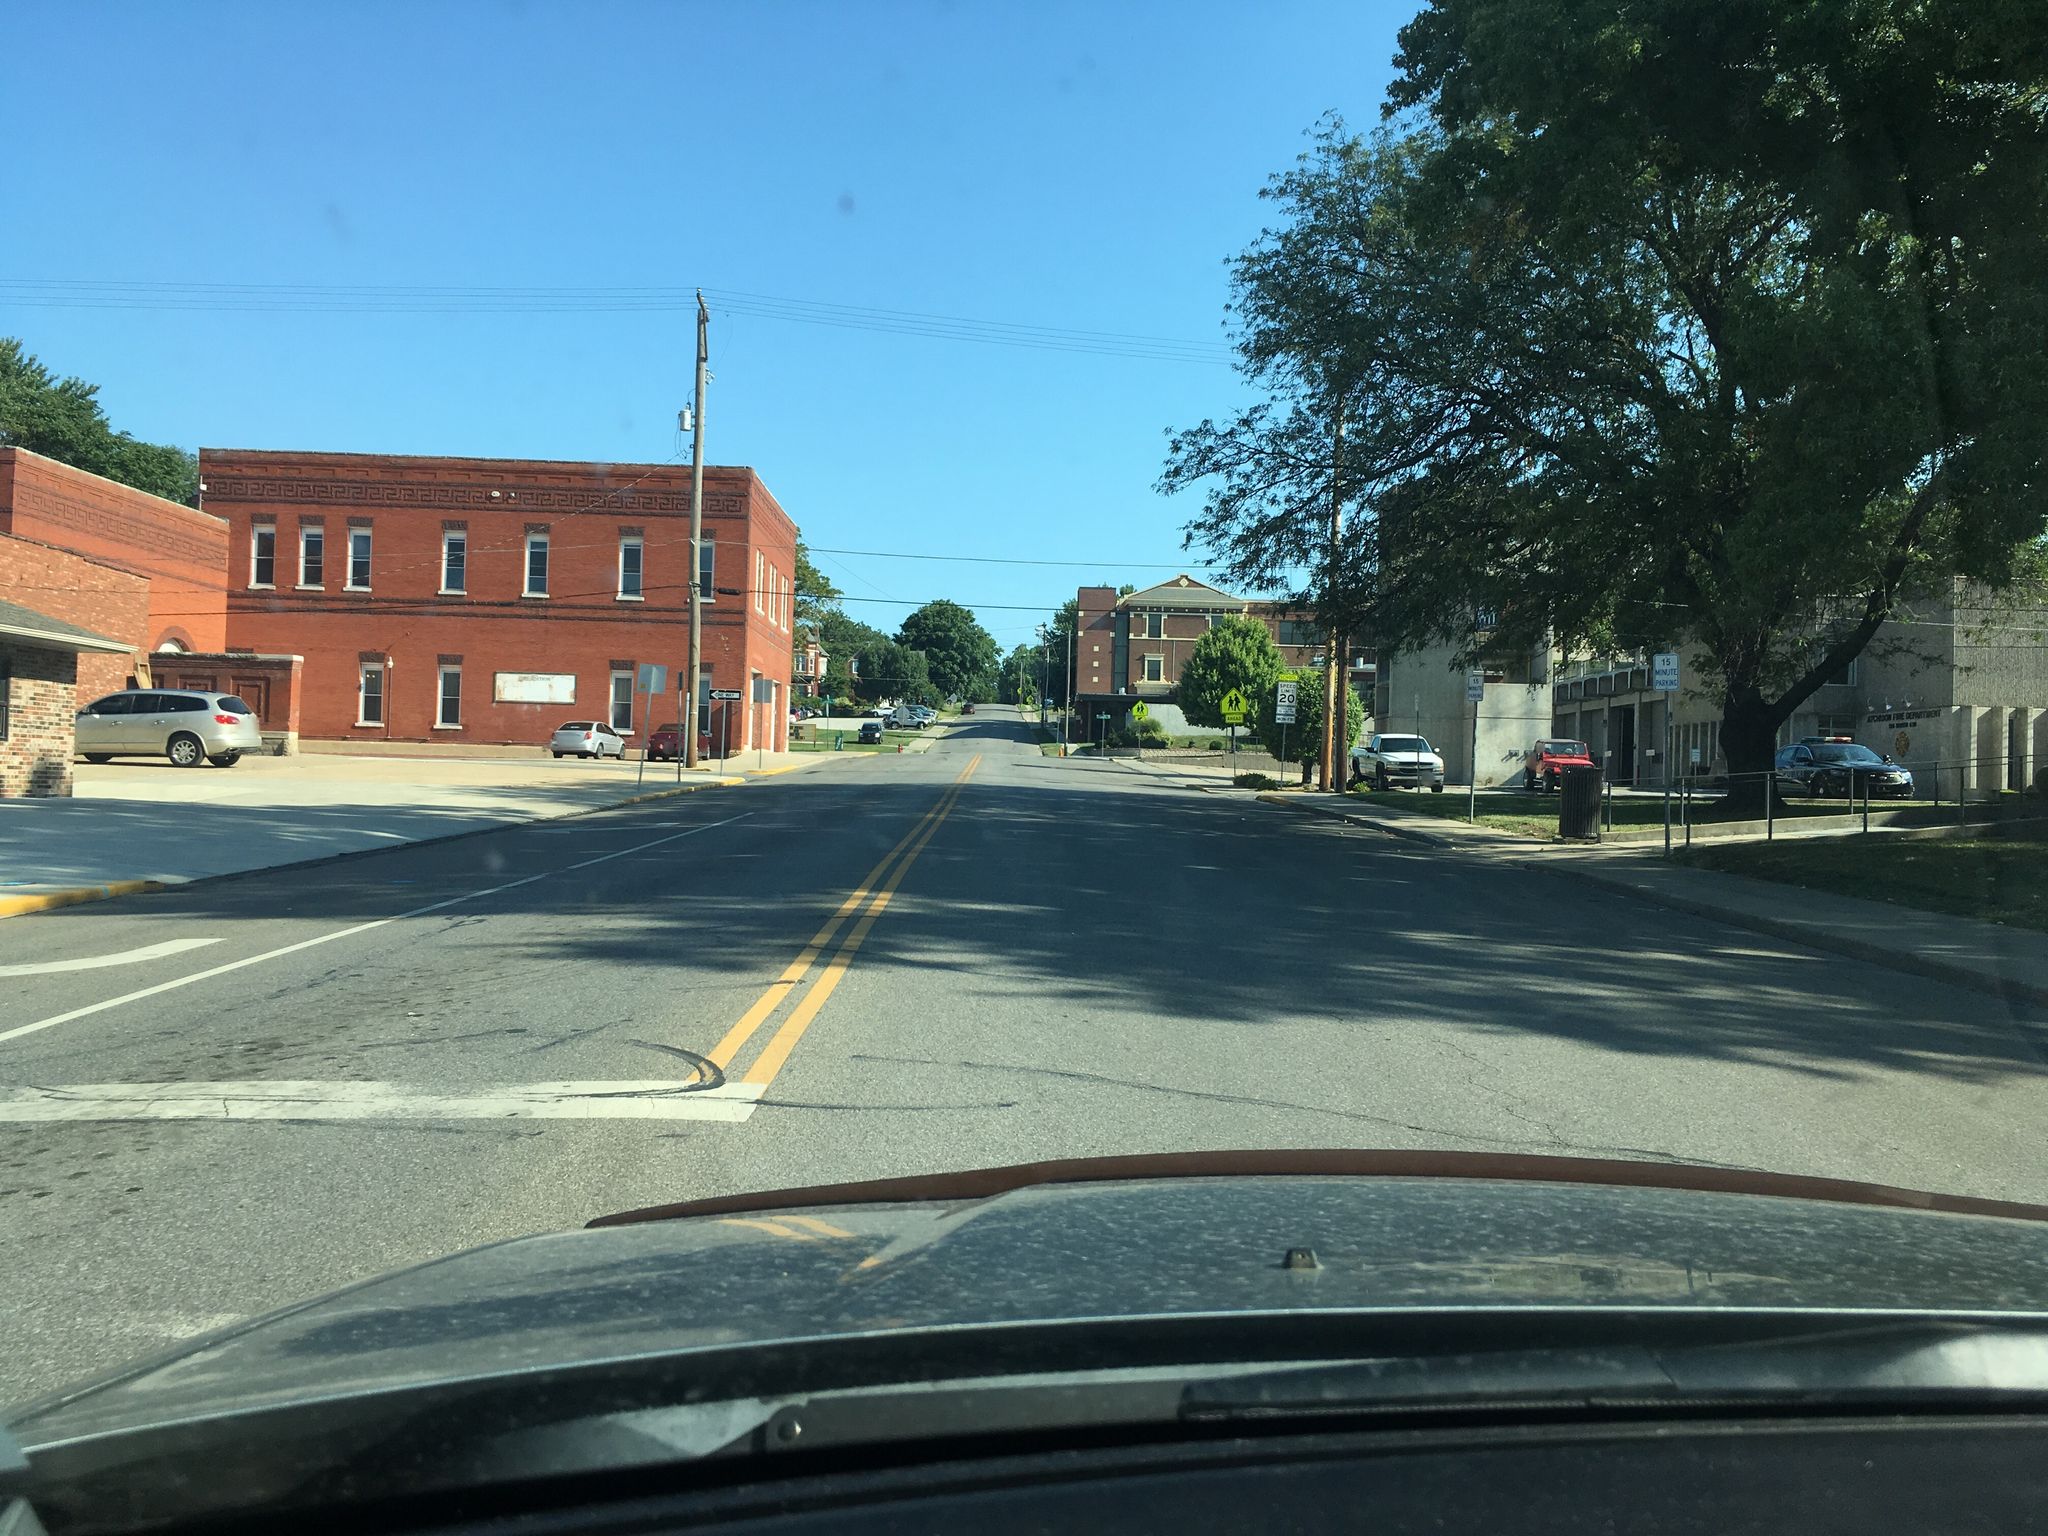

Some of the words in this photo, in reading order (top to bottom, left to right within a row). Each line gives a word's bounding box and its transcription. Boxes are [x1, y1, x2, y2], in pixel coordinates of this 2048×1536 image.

[1662, 658, 1671, 666] 15
[1656, 679, 1678, 687] PARKING
[1279, 693, 1295, 703] 20
